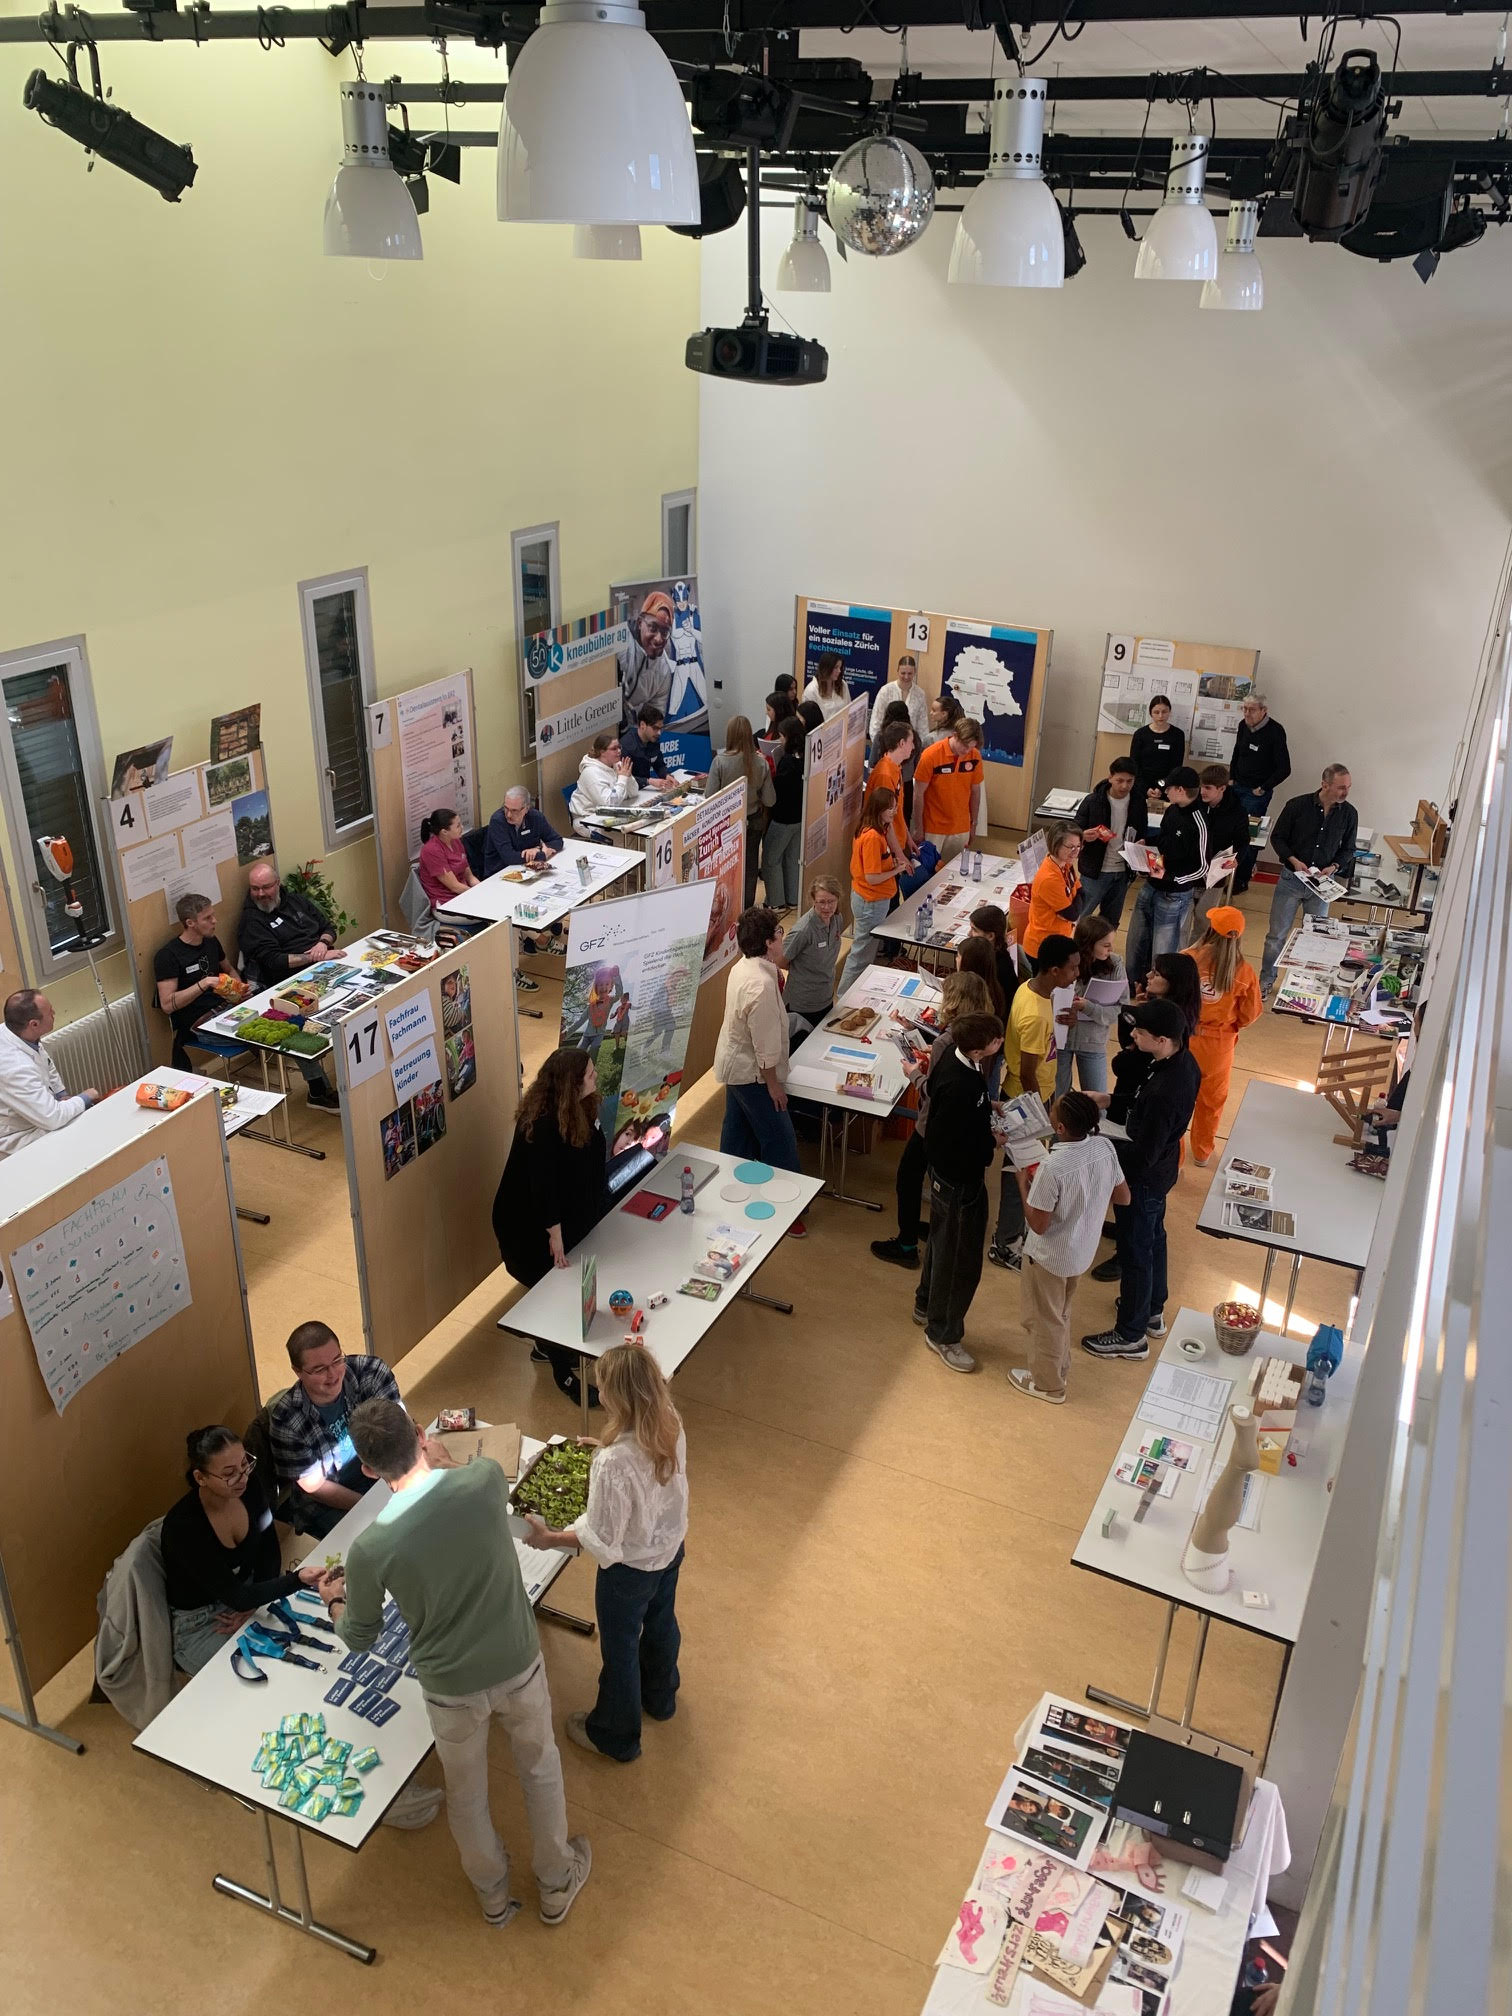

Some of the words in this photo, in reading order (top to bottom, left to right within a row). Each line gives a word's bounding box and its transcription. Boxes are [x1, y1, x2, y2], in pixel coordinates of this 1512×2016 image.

[808, 624, 831, 635] Voller
[832, 628, 861, 640] Einsatz
[862, 632, 874, 641] für
[808, 635, 821, 643] ein
[821, 636, 853, 648] soziales
[853, 640, 880, 651] Zürich
[908, 623, 928, 641] 13
[566, 631, 615, 662] kneubühler
[616, 628, 627, 643] ag
[1114, 644, 1126, 660] 9
[375, 712, 384, 735] 7
[556, 713, 582, 736] Little
[584, 699, 618, 723] Greene
[659, 739, 680, 754] ARBE
[811, 738, 823, 763] 19
[120, 803, 135, 828] 4
[656, 839, 672, 870] 16
[579, 936, 606, 952] GFZ
[389, 1004, 419, 1029] Fachfrau
[391, 1014, 427, 1043] Fachmann
[348, 1020, 379, 1065] 17
[394, 1048, 431, 1078] Betreuung
[396, 1070, 419, 1092] Kinder
[62, 1186, 128, 1240] FACHFRAU
